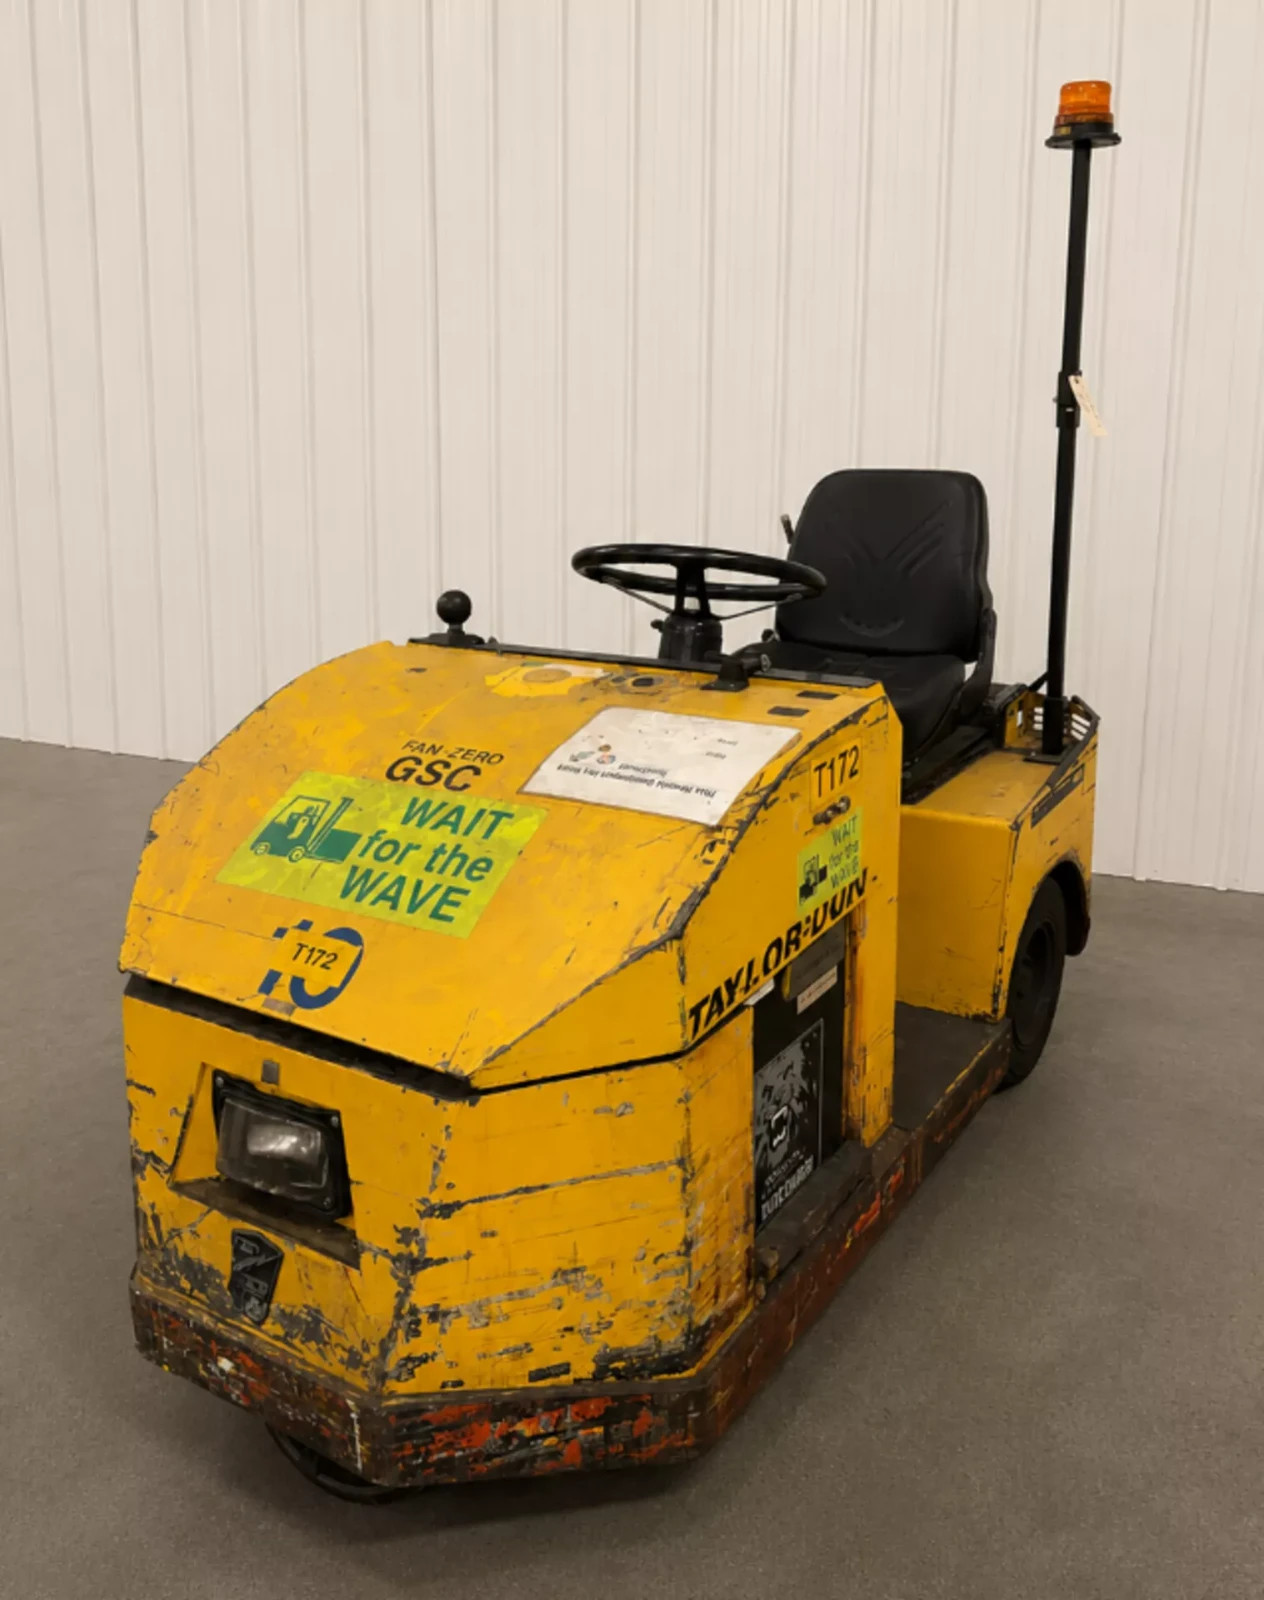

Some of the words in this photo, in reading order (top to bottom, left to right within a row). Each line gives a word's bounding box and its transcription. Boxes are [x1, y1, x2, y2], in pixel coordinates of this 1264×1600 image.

[385, 756, 482, 792] GSC
[813, 745, 859, 799] T172
[400, 796, 515, 840] WAIT
[832, 814, 858, 847] WAIT
[358, 829, 422, 866] for
[424, 843, 494, 882] the
[340, 864, 472, 923] WAVE
[292, 941, 338, 970] T172
